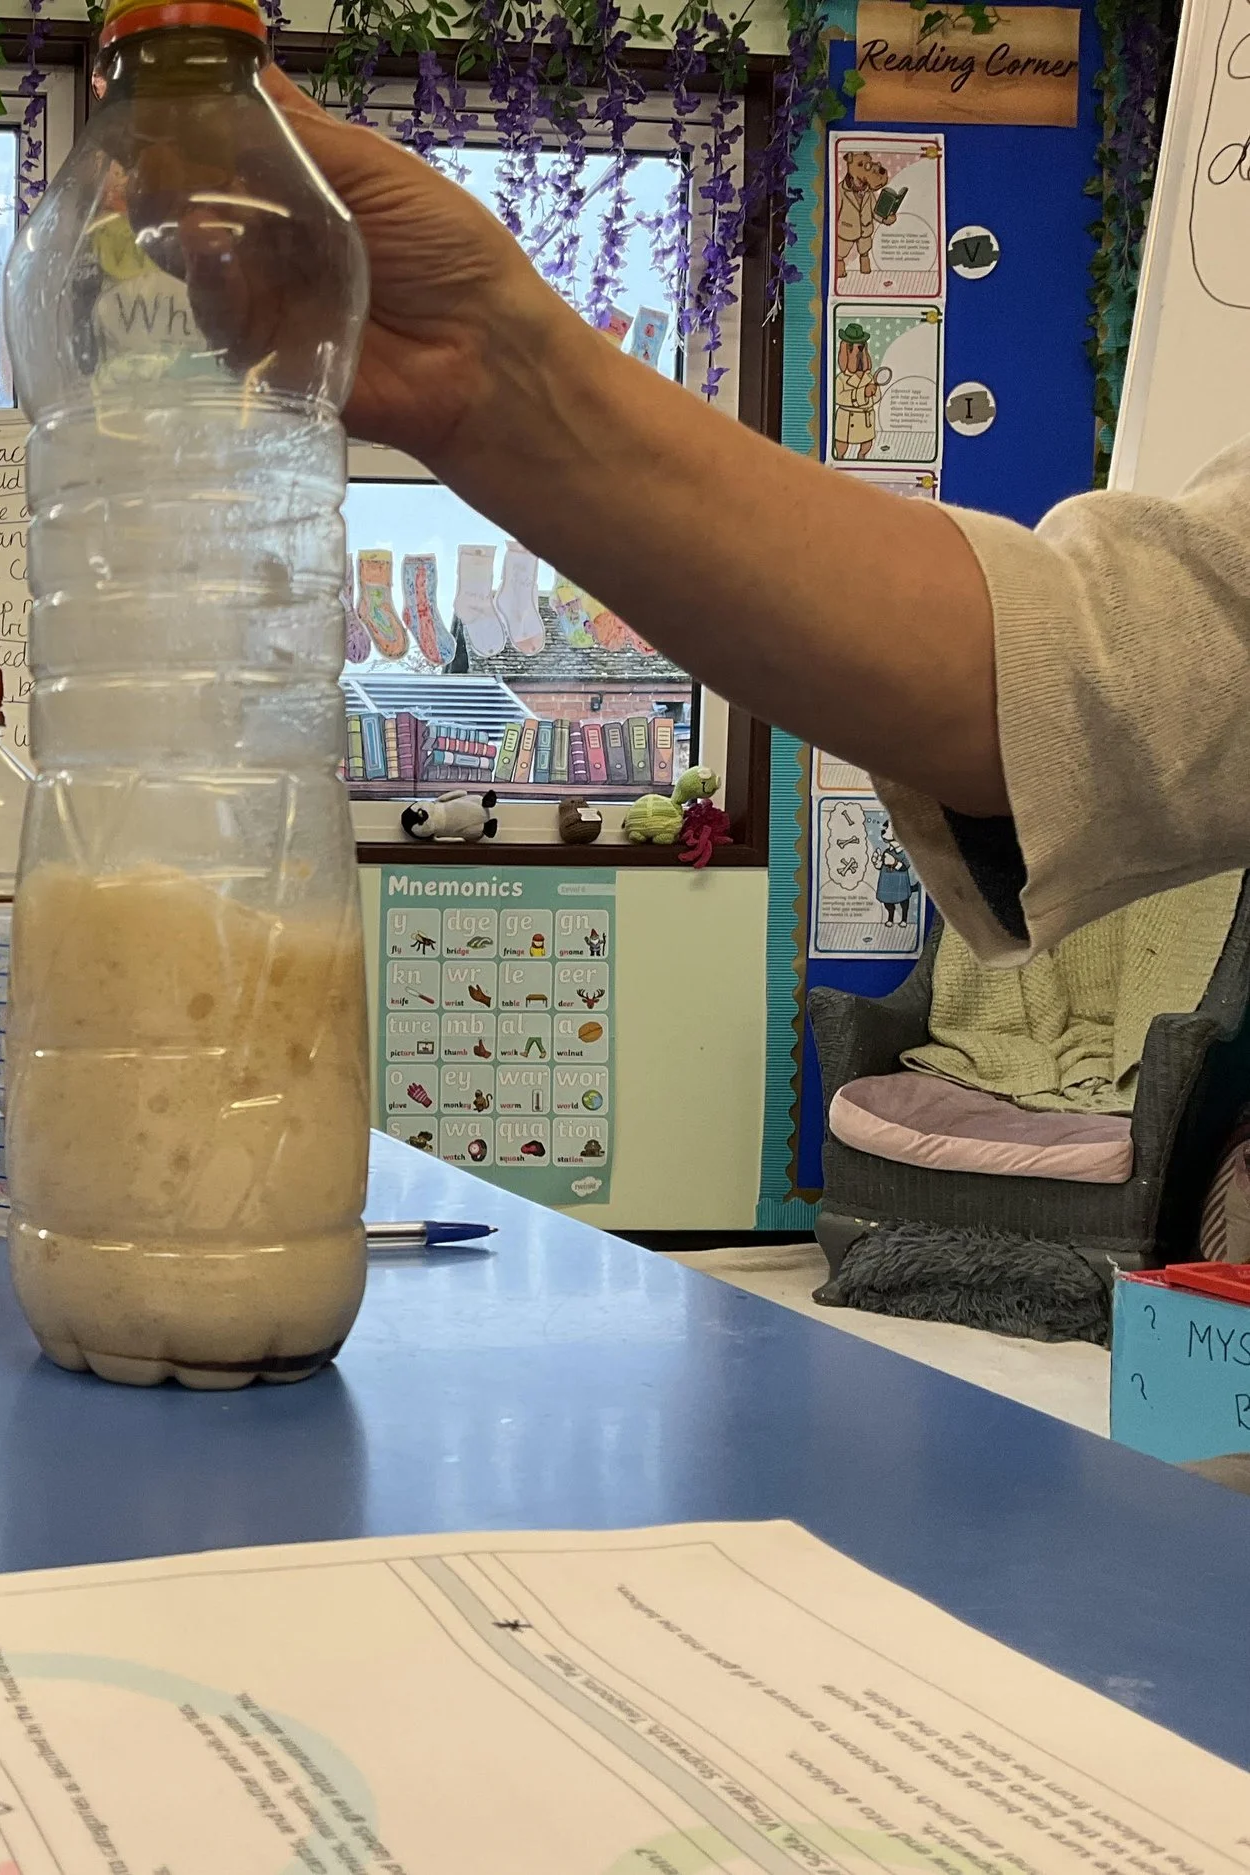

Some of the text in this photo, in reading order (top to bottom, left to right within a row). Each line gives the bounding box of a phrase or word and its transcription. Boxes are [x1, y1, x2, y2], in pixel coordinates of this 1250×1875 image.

[859, 38, 1078, 93] Reading Corner
[964, 242, 980, 263] V
[116, 292, 191, 336] Wh
[389, 875, 522, 897] Mnemonics
[393, 914, 406, 935] y
[447, 909, 490, 937] dge
[506, 914, 532, 936] ge
[560, 914, 590, 936] gn
[391, 945, 402, 955] fly
[446, 947, 470, 956] bridge
[503, 947, 525, 957] fringe
[559, 949, 584, 957] gnome
[392, 963, 421, 984] kn
[447, 968, 481, 982] wr
[504, 963, 524, 984] le
[559, 968, 597, 983] eer
[390, 998, 409, 1006] knife
[445, 999, 464, 1007] wrist
[502, 999, 520, 1007] table
[389, 1017, 431, 1033] ture
[447, 1013, 484, 1034] mb
[501, 1013, 524, 1035] al
[558, 1019, 573, 1034] a
[390, 1049, 415, 1058] picture
[500, 1049, 519, 1057] walk
[556, 1049, 583, 1057] walnut
[390, 1071, 403, 1085] o
[445, 1071, 471, 1092] ey
[500, 1071, 549, 1086] war
[556, 1071, 606, 1087] wor
[388, 1102, 407, 1110] glove
[443, 1102, 472, 1110] monkey
[556, 1102, 579, 1110] world
[391, 1122, 401, 1136] s
[445, 1122, 481, 1137] wa
[500, 1122, 545, 1142] qua
[558, 1120, 601, 1138] tion
[442, 1153, 466, 1161] watch
[500, 1155, 525, 1163] squash
[557, 1155, 583, 1163] station
[810, 1720, 831, 1732] to
[828, 1733, 889, 1773] bottom
[886, 1775, 918, 1794] the
[718, 1780, 781, 1832] Vinegar,
[859, 1806, 899, 1830] into
